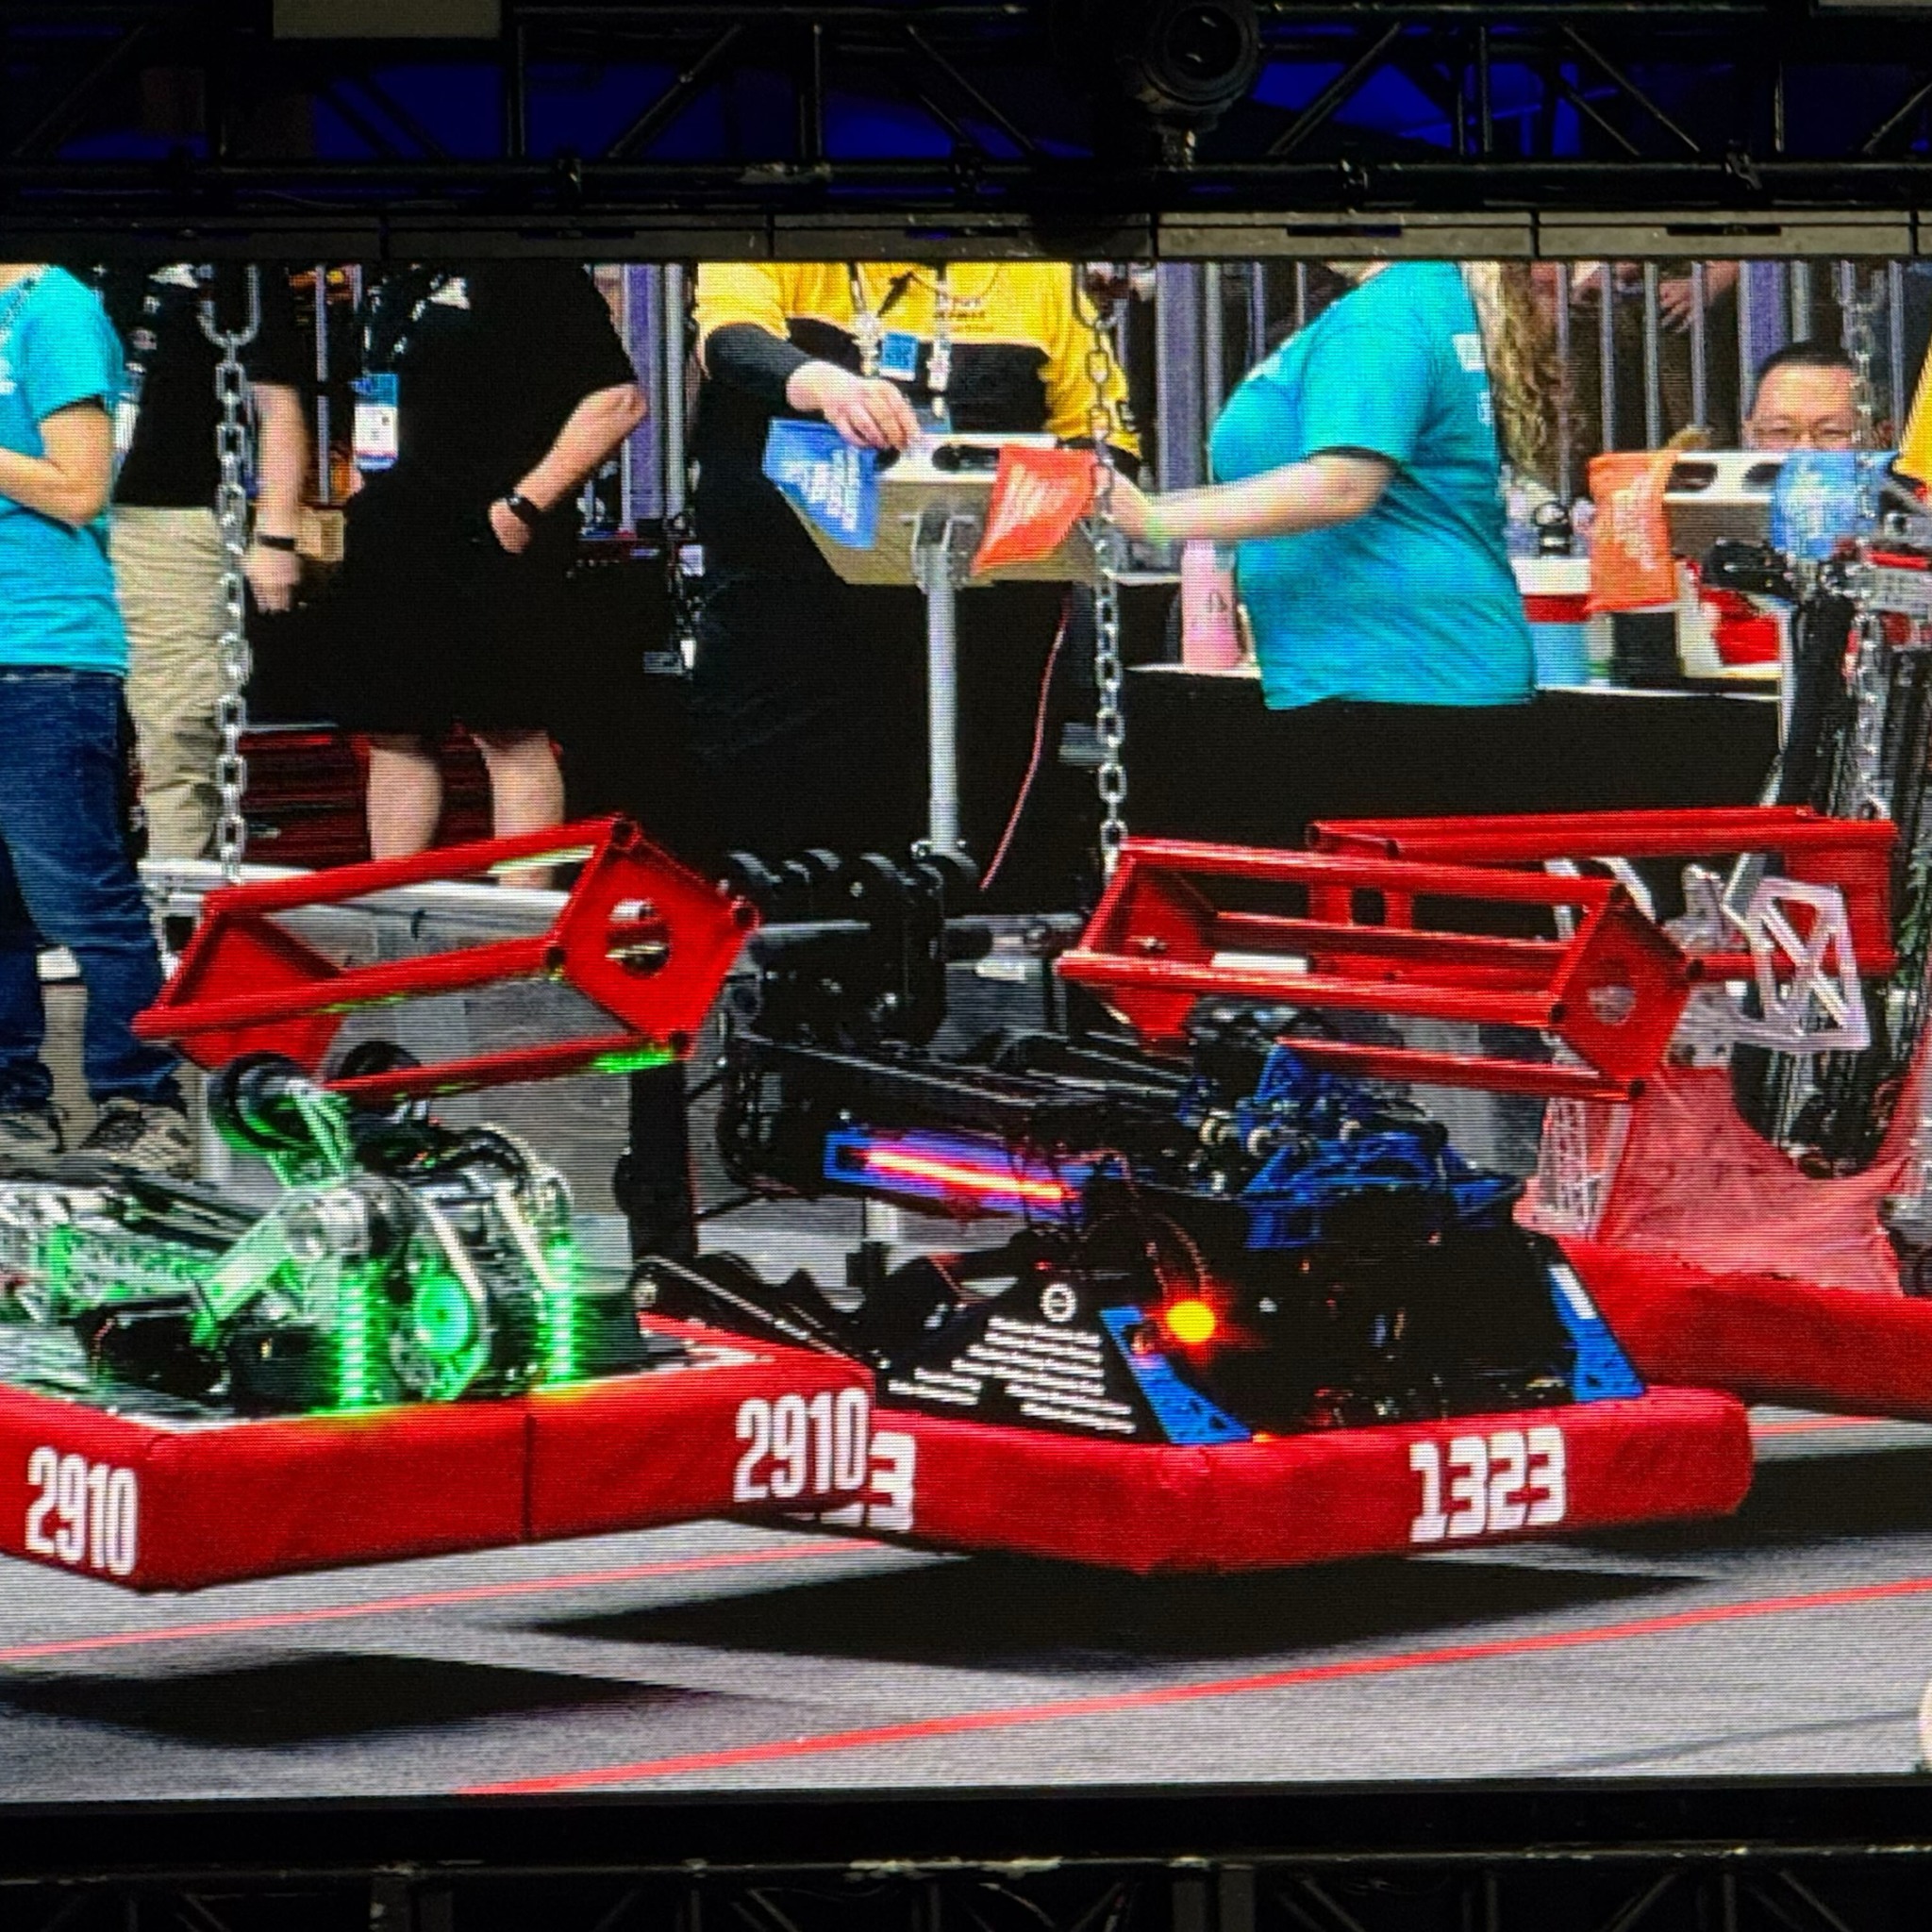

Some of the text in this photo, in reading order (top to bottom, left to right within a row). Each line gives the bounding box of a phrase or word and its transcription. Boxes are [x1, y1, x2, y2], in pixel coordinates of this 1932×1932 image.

[733, 1387, 869, 1502] 2910
[1409, 1426, 1566, 1542] 1323
[25, 1446, 138, 1575] 2910
